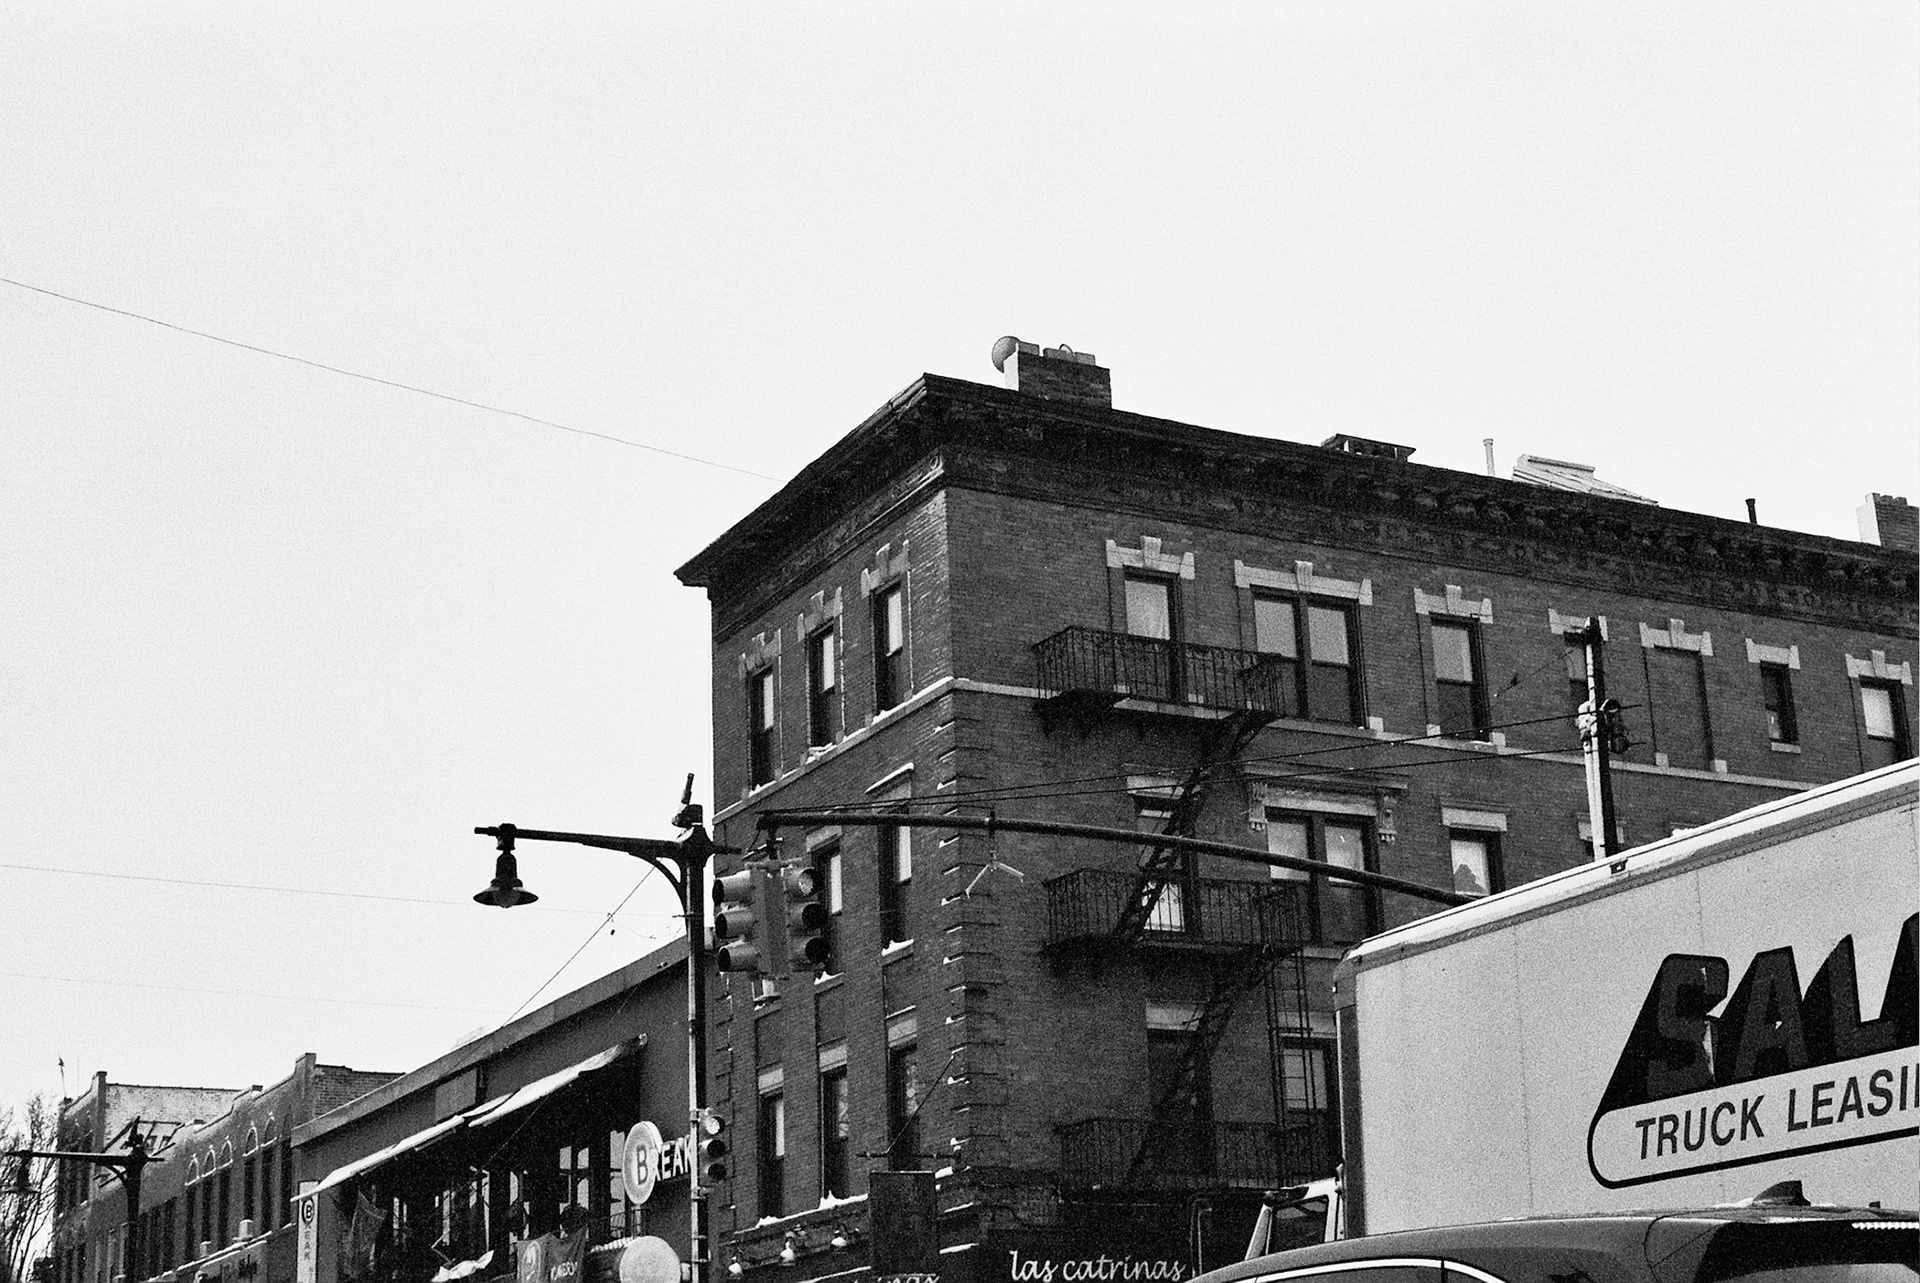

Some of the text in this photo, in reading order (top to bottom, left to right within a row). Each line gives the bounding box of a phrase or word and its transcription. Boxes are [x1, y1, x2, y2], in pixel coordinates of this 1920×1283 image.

[1628, 913, 1919, 1099] SAL
[1635, 1062, 1919, 1160] TRUCK LEASI
[636, 1135, 692, 1186] BEAK
[1009, 1250, 1186, 1282] las catrinas
